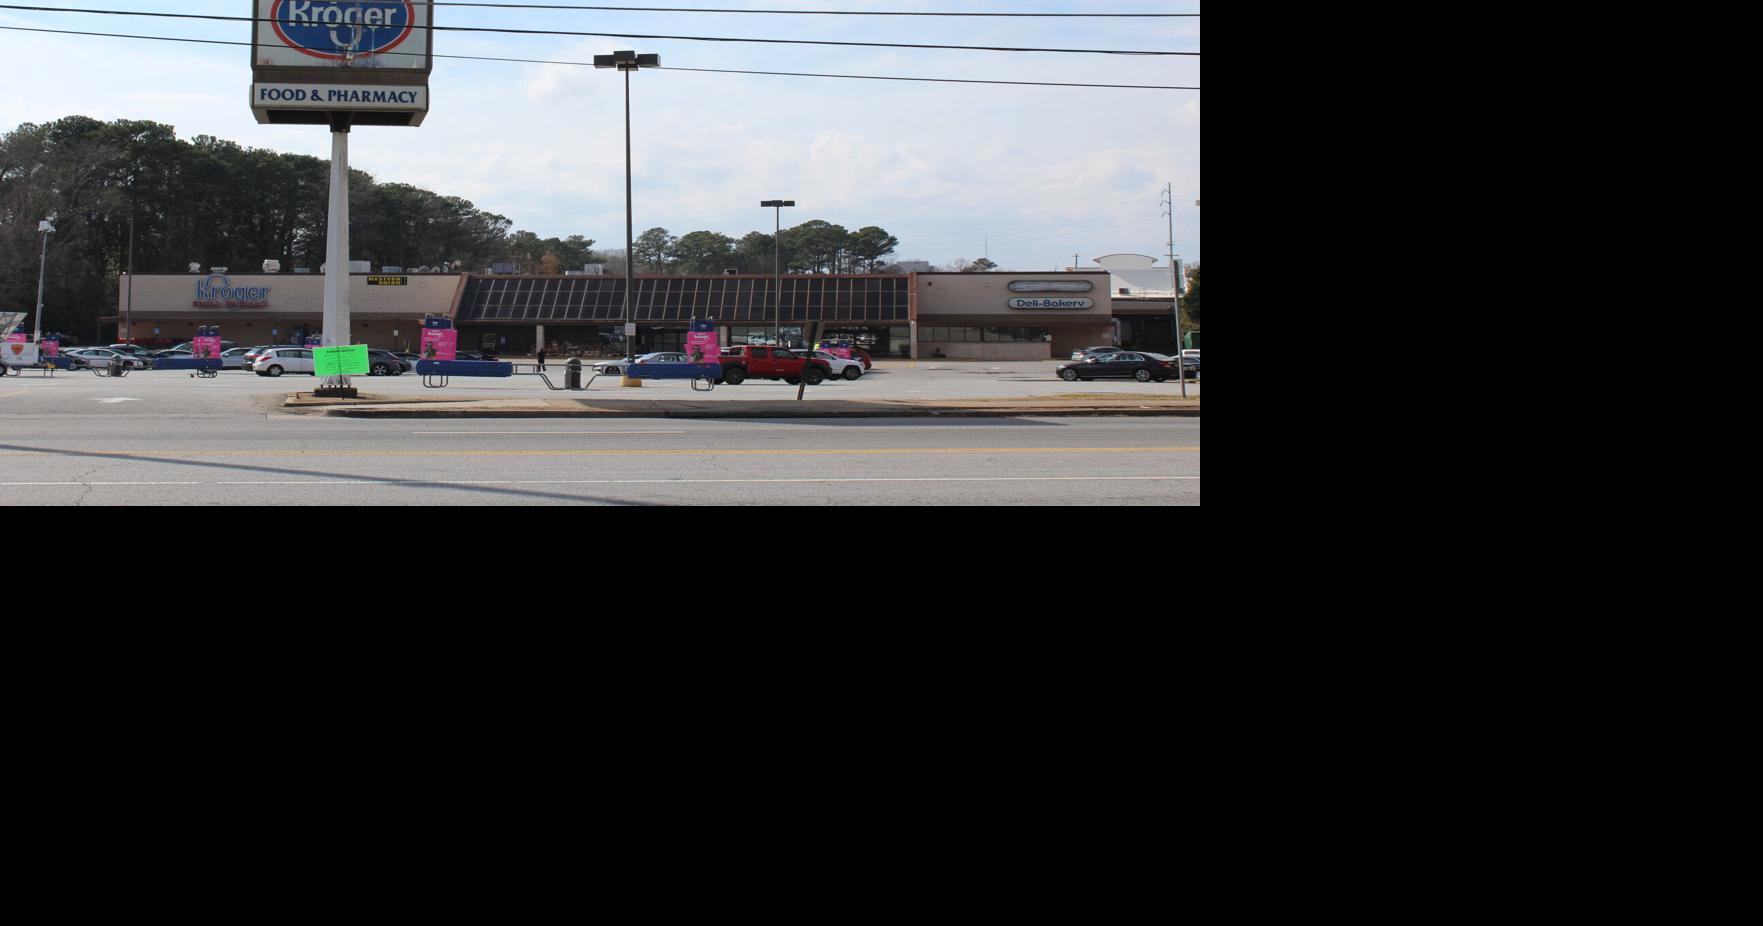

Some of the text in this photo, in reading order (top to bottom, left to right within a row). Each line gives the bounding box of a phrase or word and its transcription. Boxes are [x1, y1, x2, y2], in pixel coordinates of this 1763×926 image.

[289, 0, 397, 47] Kroger
[260, 88, 418, 104] FOOD & PHARMACY
[196, 274, 270, 309] Kroger
[1017, 299, 1085, 307] Deli-Bakery
